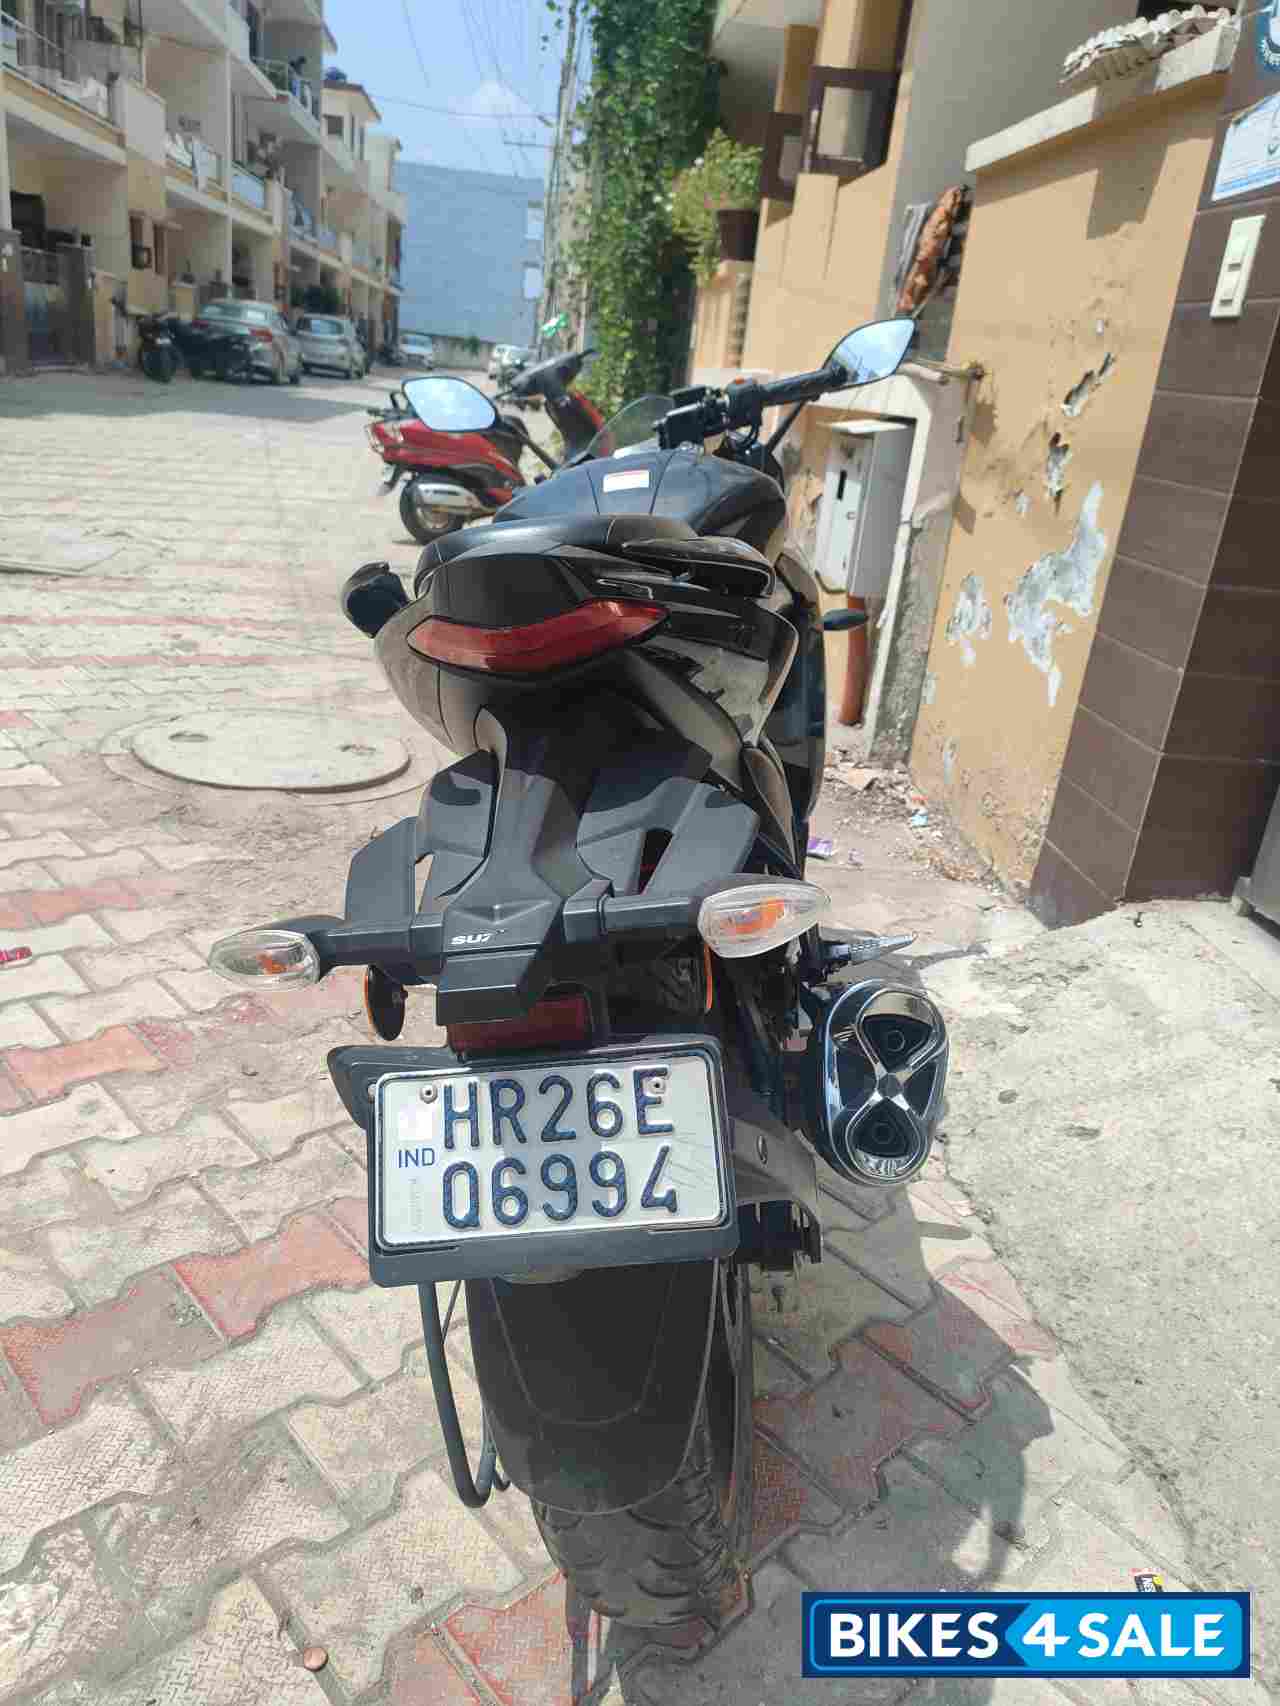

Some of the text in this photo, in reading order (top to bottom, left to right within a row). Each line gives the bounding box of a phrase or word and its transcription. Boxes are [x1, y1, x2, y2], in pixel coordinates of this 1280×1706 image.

[451, 930, 505, 945] SUZ
[443, 1066, 673, 1149] HR26E
[398, 1147, 435, 1168] IND
